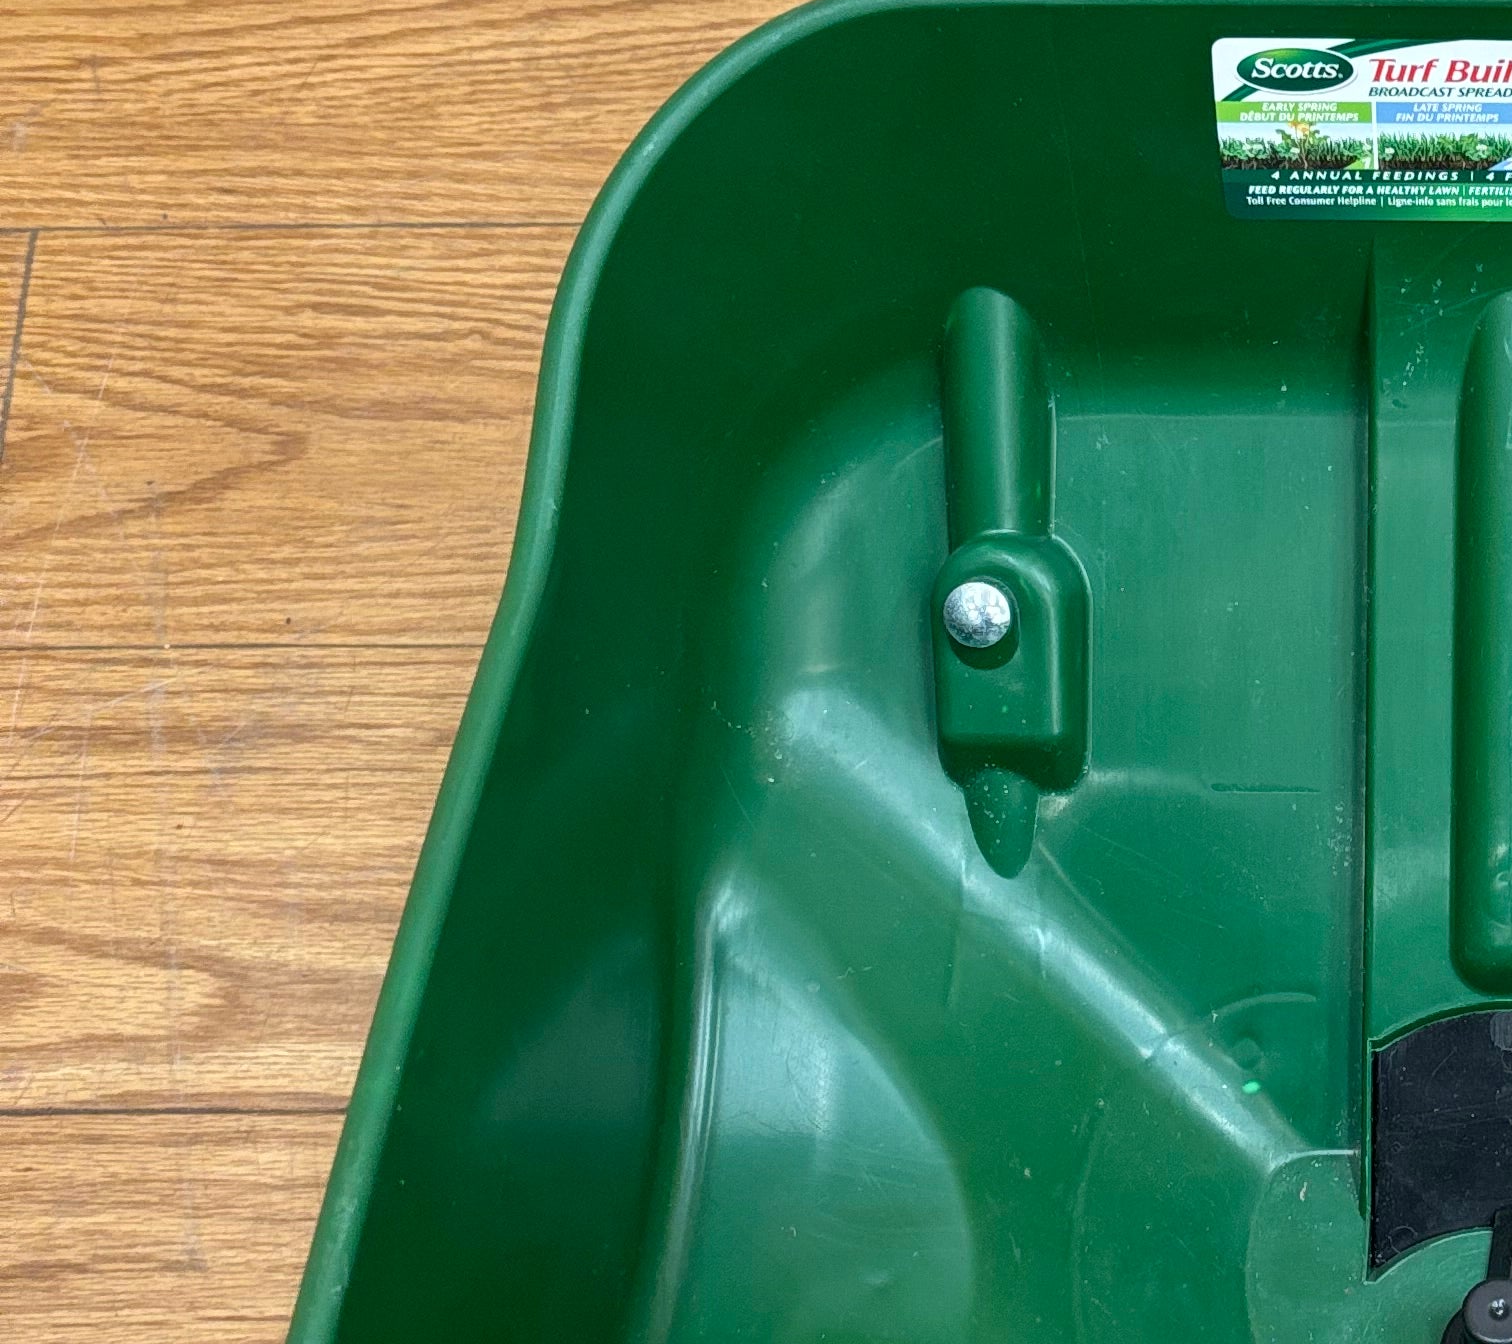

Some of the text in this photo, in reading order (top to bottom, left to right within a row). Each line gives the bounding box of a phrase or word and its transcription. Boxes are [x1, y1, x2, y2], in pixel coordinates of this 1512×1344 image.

[1252, 57, 1338, 80] Scotts
[1369, 58, 1439, 82] Turf
[1369, 87, 1454, 98] BROADCAST
[1261, 103, 1337, 112] EARLY SPRING
[1413, 103, 1482, 113] LATE SPRING
[1239, 110, 1359, 123] DÉBUT DU PRINTEMPS
[1396, 112, 1499, 124] FIN DU PRINTEMPS
[1362, 157, 1372, 169] 1
[1271, 171, 1280, 180] 4
[1290, 171, 1363, 181] ANNUAL
[1372, 171, 1459, 182] FEEDINGS
[1485, 172, 1495, 182] 4
[1249, 185, 1276, 195] FEED
[1279, 185, 1339, 195] REGULARLY
[1341, 185, 1364, 195] FOR
[1365, 185, 1374, 195] A
[1377, 186, 1426, 196] HEALTHY
[1428, 186, 1460, 196] LAWN
[1246, 196, 1265, 205] Toll
[1266, 196, 1286, 205] Free
[1289, 196, 1335, 206] Consumer
[1337, 196, 1376, 207] Helpline
[1388, 197, 1434, 208] Ligne-info
[1436, 199, 1456, 207] sans
[1459, 197, 1479, 207] frais
[1481, 199, 1504, 208] pour
